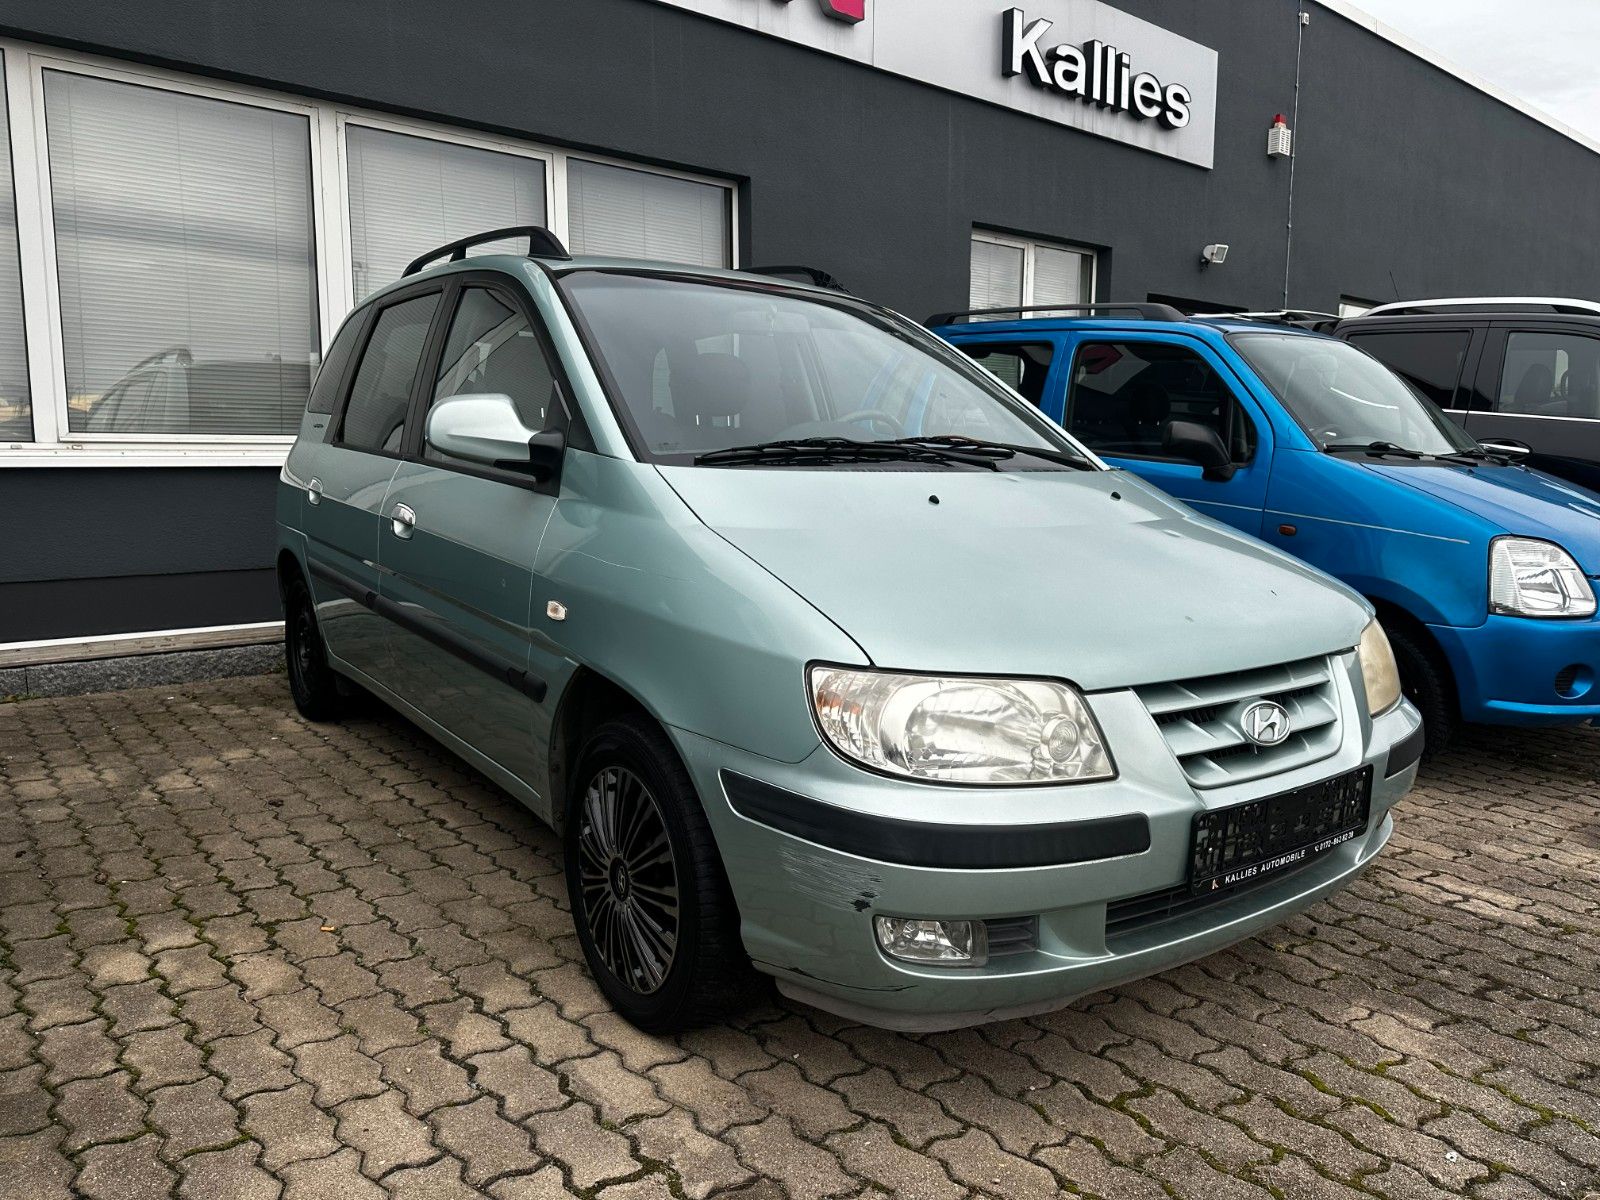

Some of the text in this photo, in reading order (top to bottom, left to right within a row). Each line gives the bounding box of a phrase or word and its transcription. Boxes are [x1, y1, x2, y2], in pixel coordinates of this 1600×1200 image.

[1003, 7, 1191, 129] Kallies
[1225, 866, 1257, 884] KALLIES
[1260, 849, 1306, 873] AUTOMOBILE
